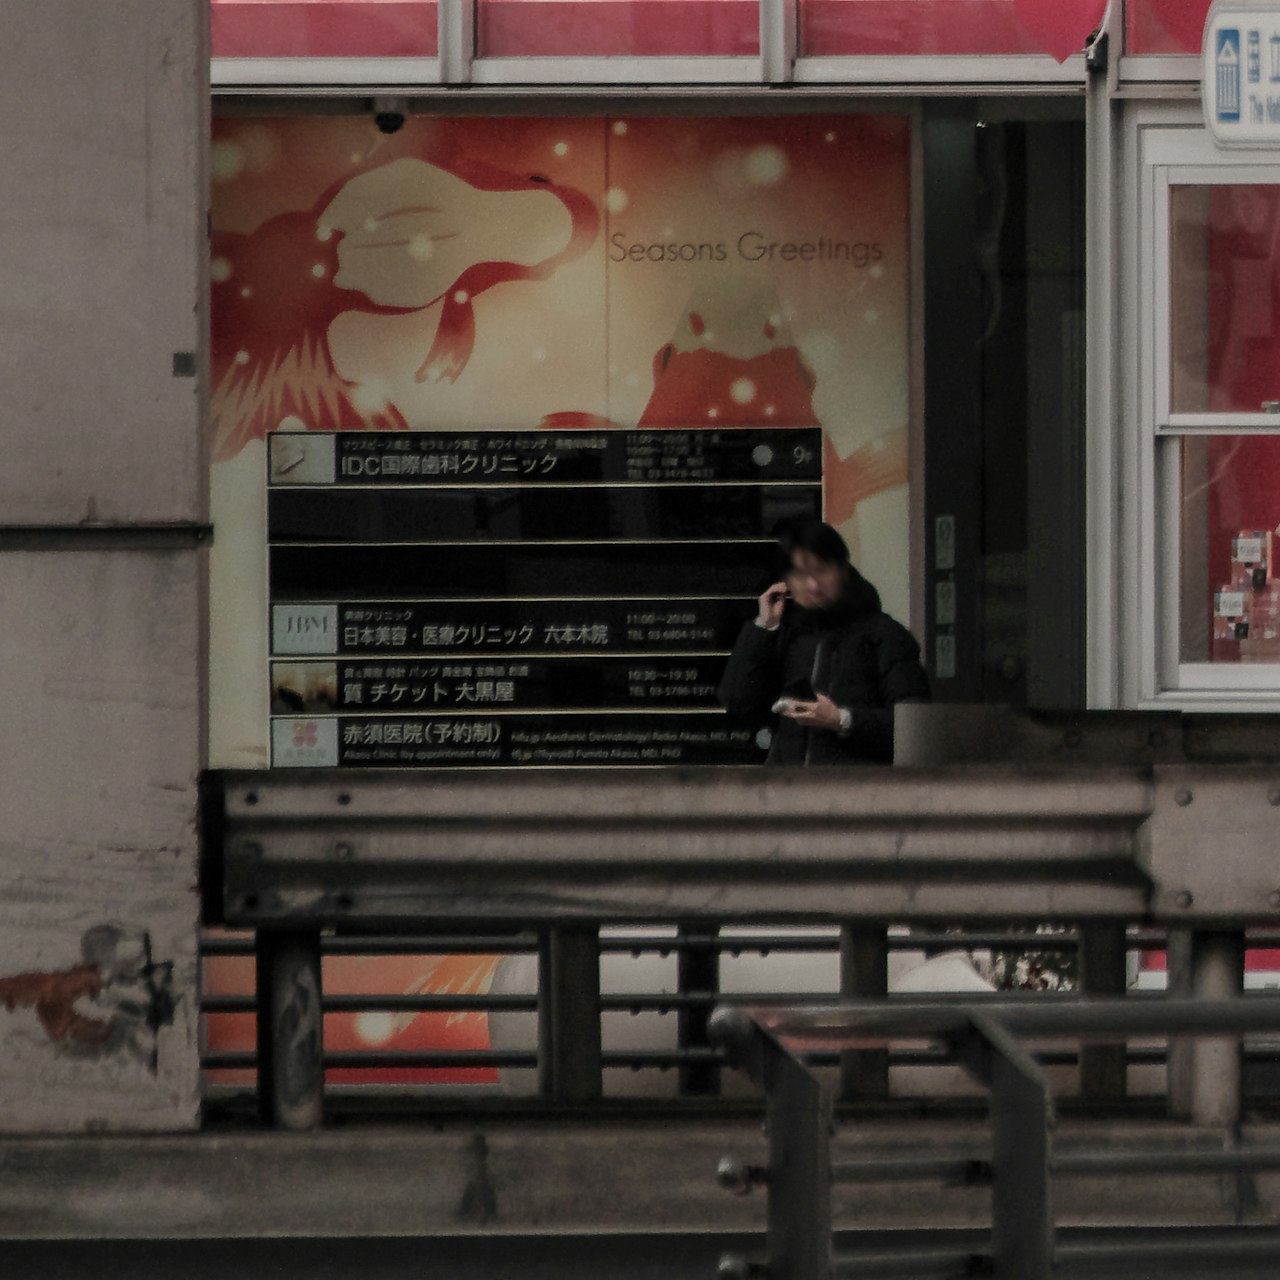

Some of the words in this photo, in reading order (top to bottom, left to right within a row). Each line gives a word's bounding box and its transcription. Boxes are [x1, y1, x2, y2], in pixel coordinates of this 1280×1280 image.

[609, 231, 729, 264] Seasons
[737, 230, 884, 269] Greetings
[341, 452, 558, 477] IDC国際歯科クリニック
[369, 682, 449, 704] チケット
[454, 681, 516, 703] 大黒屋
